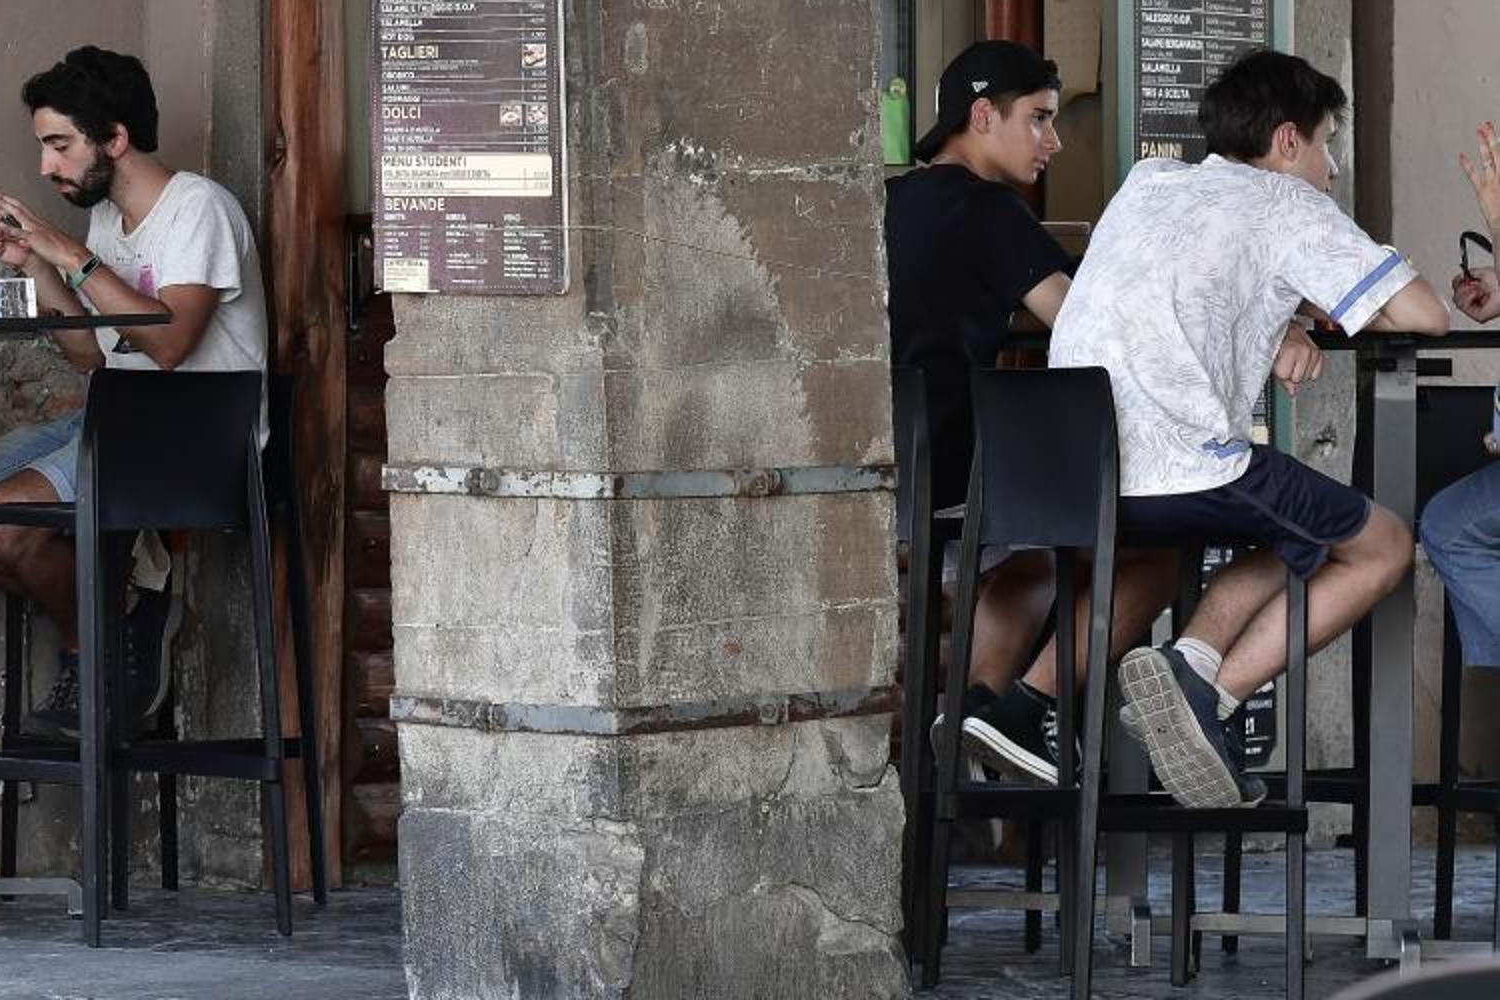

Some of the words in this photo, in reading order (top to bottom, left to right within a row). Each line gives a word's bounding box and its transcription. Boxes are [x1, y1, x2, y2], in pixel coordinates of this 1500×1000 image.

[380, 44, 439, 59] TAGLIERI
[382, 106, 421, 120] DOLCI
[1141, 140, 1184, 160] PANINI
[415, 156, 468, 168] STUDENTI
[384, 198, 446, 212] BEVANDE
